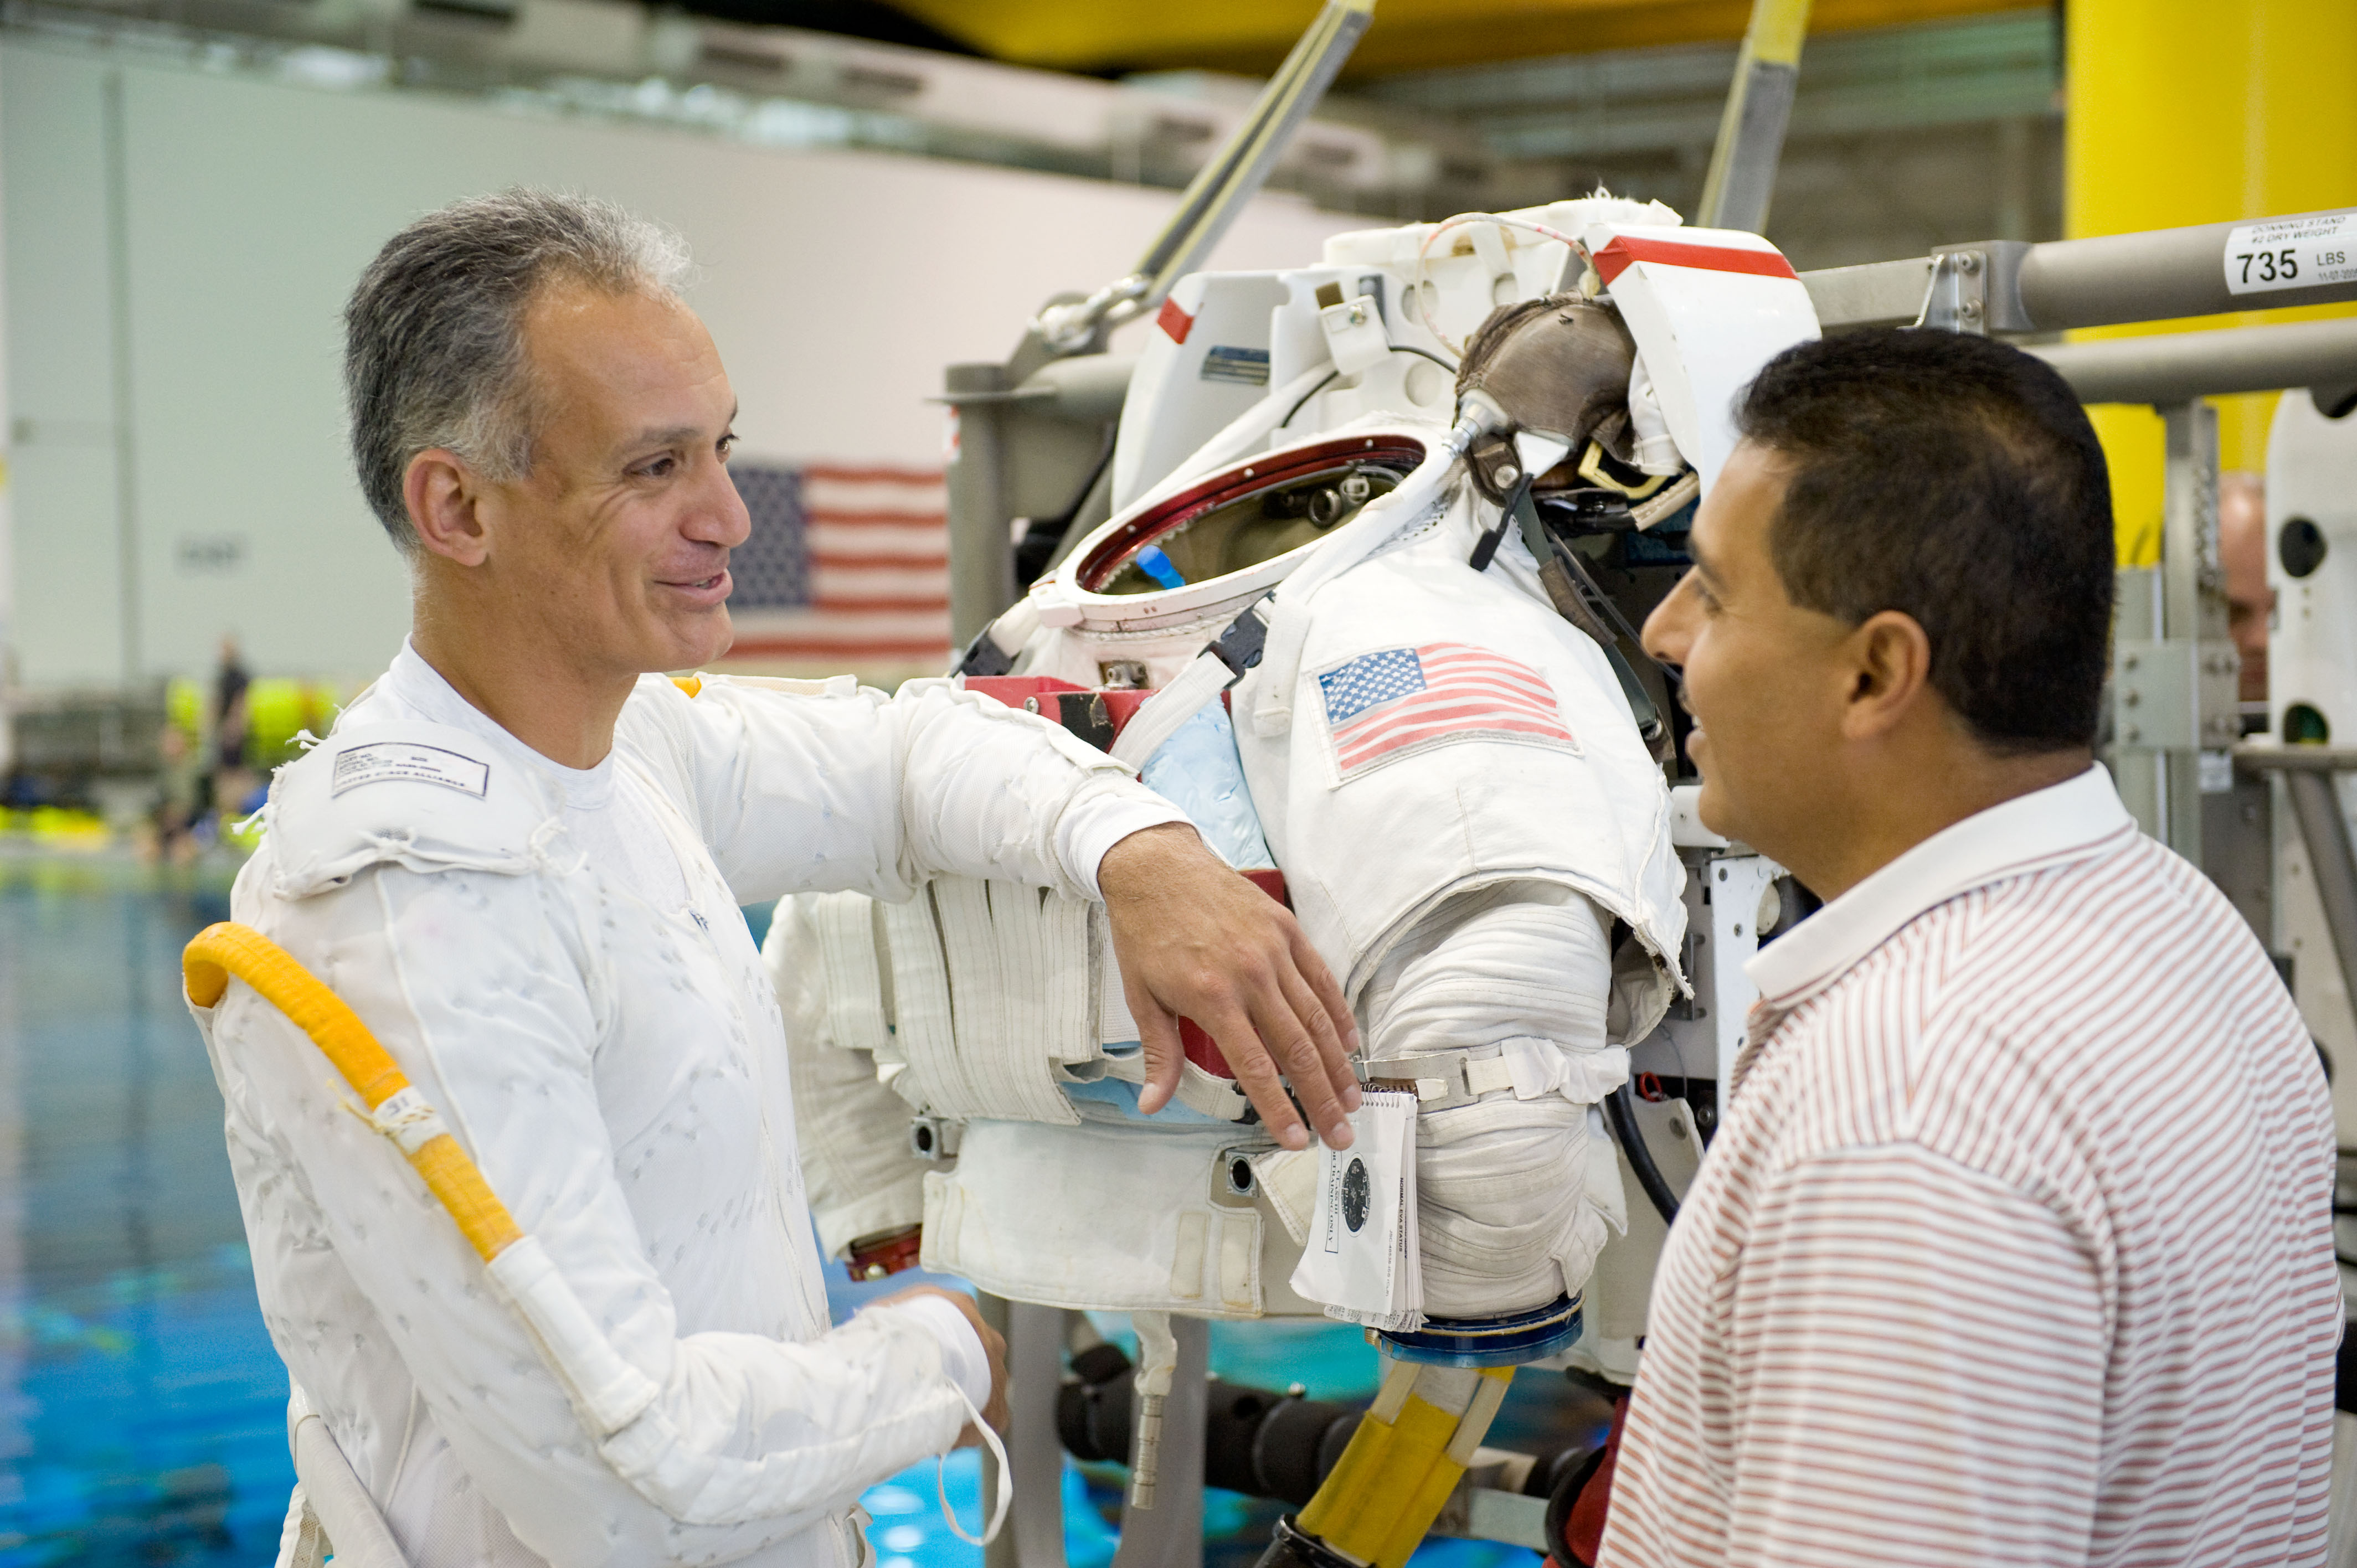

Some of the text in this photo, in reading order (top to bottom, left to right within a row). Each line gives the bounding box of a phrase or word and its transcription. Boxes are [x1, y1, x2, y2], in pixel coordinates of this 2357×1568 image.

[2252, 215, 2346, 234] DONNING STAND
[2267, 233, 2288, 243] DRY
[2294, 226, 2338, 239] WEIGHT
[2237, 249, 2345, 283] 735 LBS
